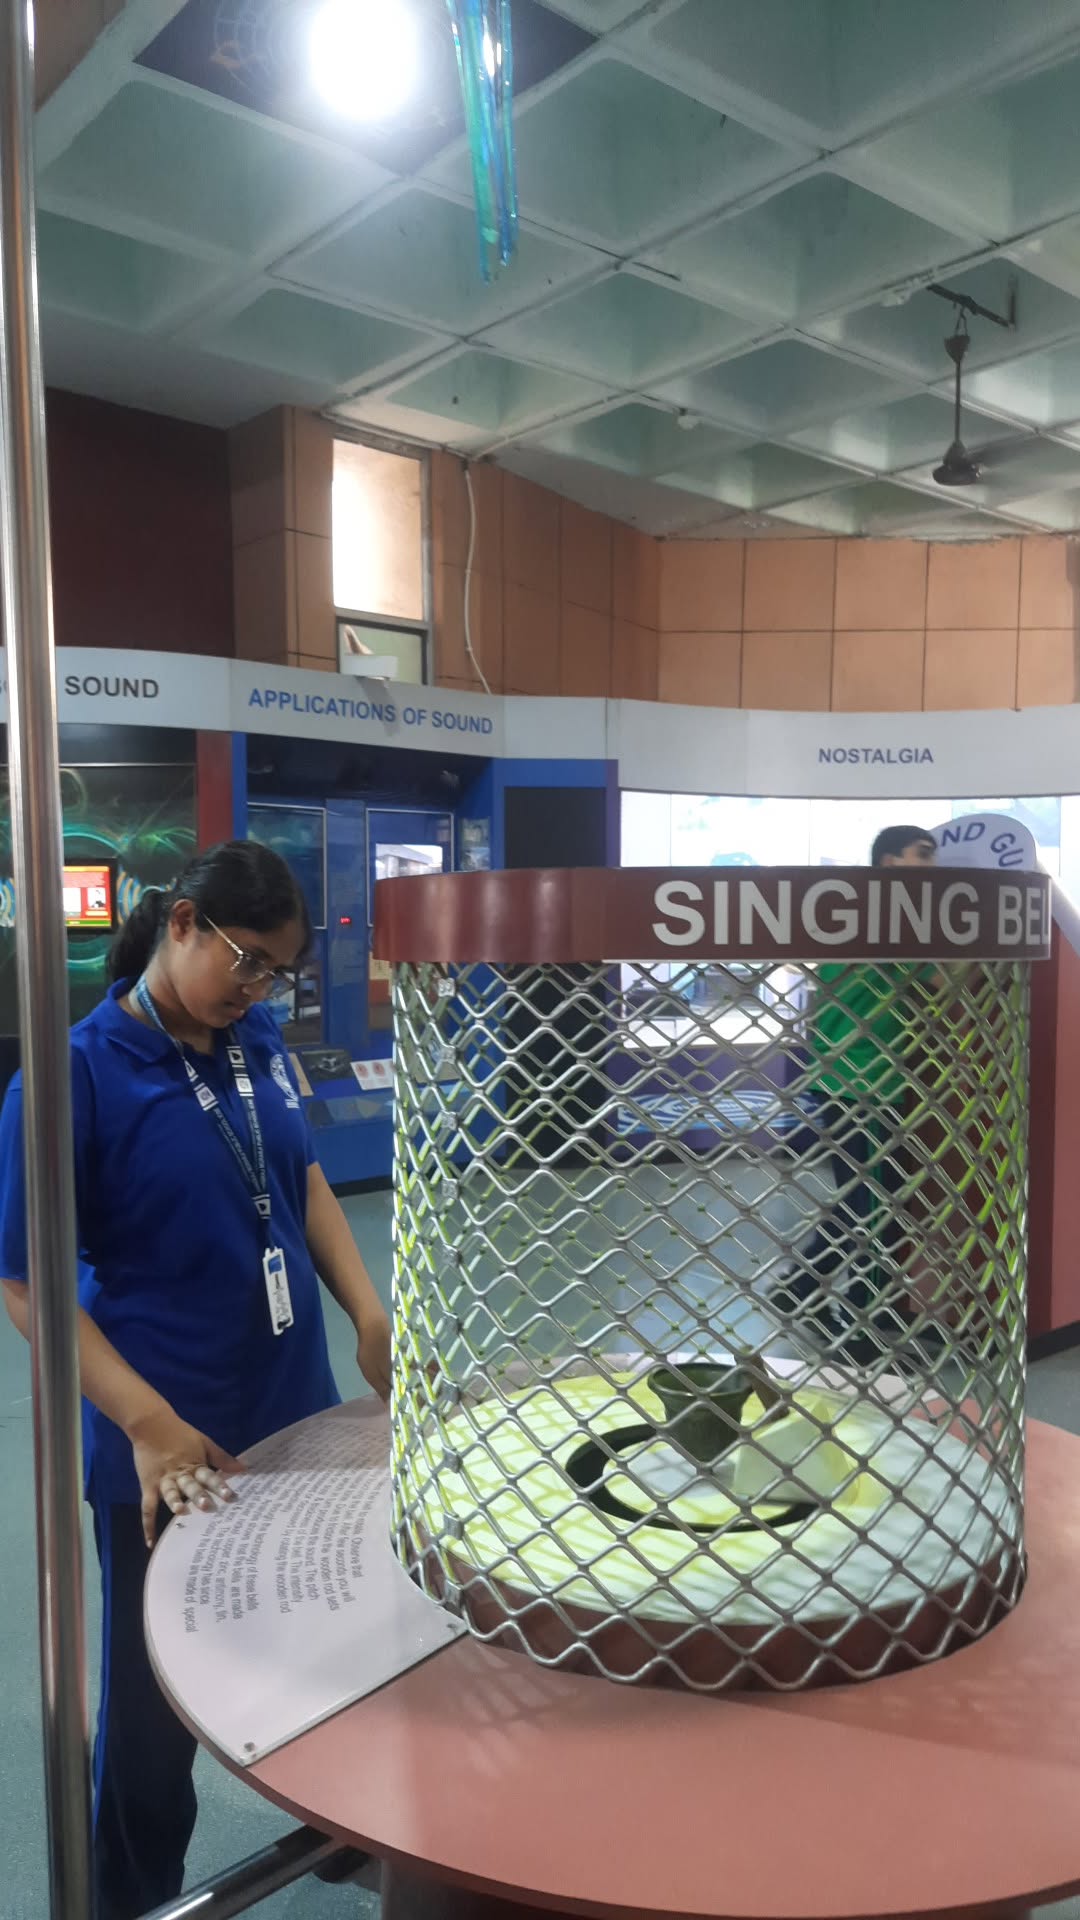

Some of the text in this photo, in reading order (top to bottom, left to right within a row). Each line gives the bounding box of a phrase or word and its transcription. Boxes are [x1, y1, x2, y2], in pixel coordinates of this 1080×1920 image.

[65, 675, 159, 698] SOUND
[248, 688, 493, 734] APPLICATIONS OF SOUND
[818, 748, 934, 764] NOSTALGIA
[942, 822, 1025, 867] ND GU
[652, 879, 1050, 946] SINGING BEL
[351, 1537, 362, 1564] Observe
[320, 1557, 331, 1582] wooden
[336, 1549, 346, 1577] seconds
[351, 1565, 362, 1578] that
[185, 1576, 197, 1596] made
[305, 1569, 317, 1582] The
[336, 1578, 348, 1590] you
[231, 1586, 240, 1598] are
[276, 1573, 287, 1600] wooden
[304, 1584, 319, 1600] pitch
[324, 1583, 336, 1595] rod
[342, 1591, 356, 1603] will
[231, 1598, 244, 1620] made
[280, 1601, 293, 1614] rod
[181, 1606, 200, 1633] special
